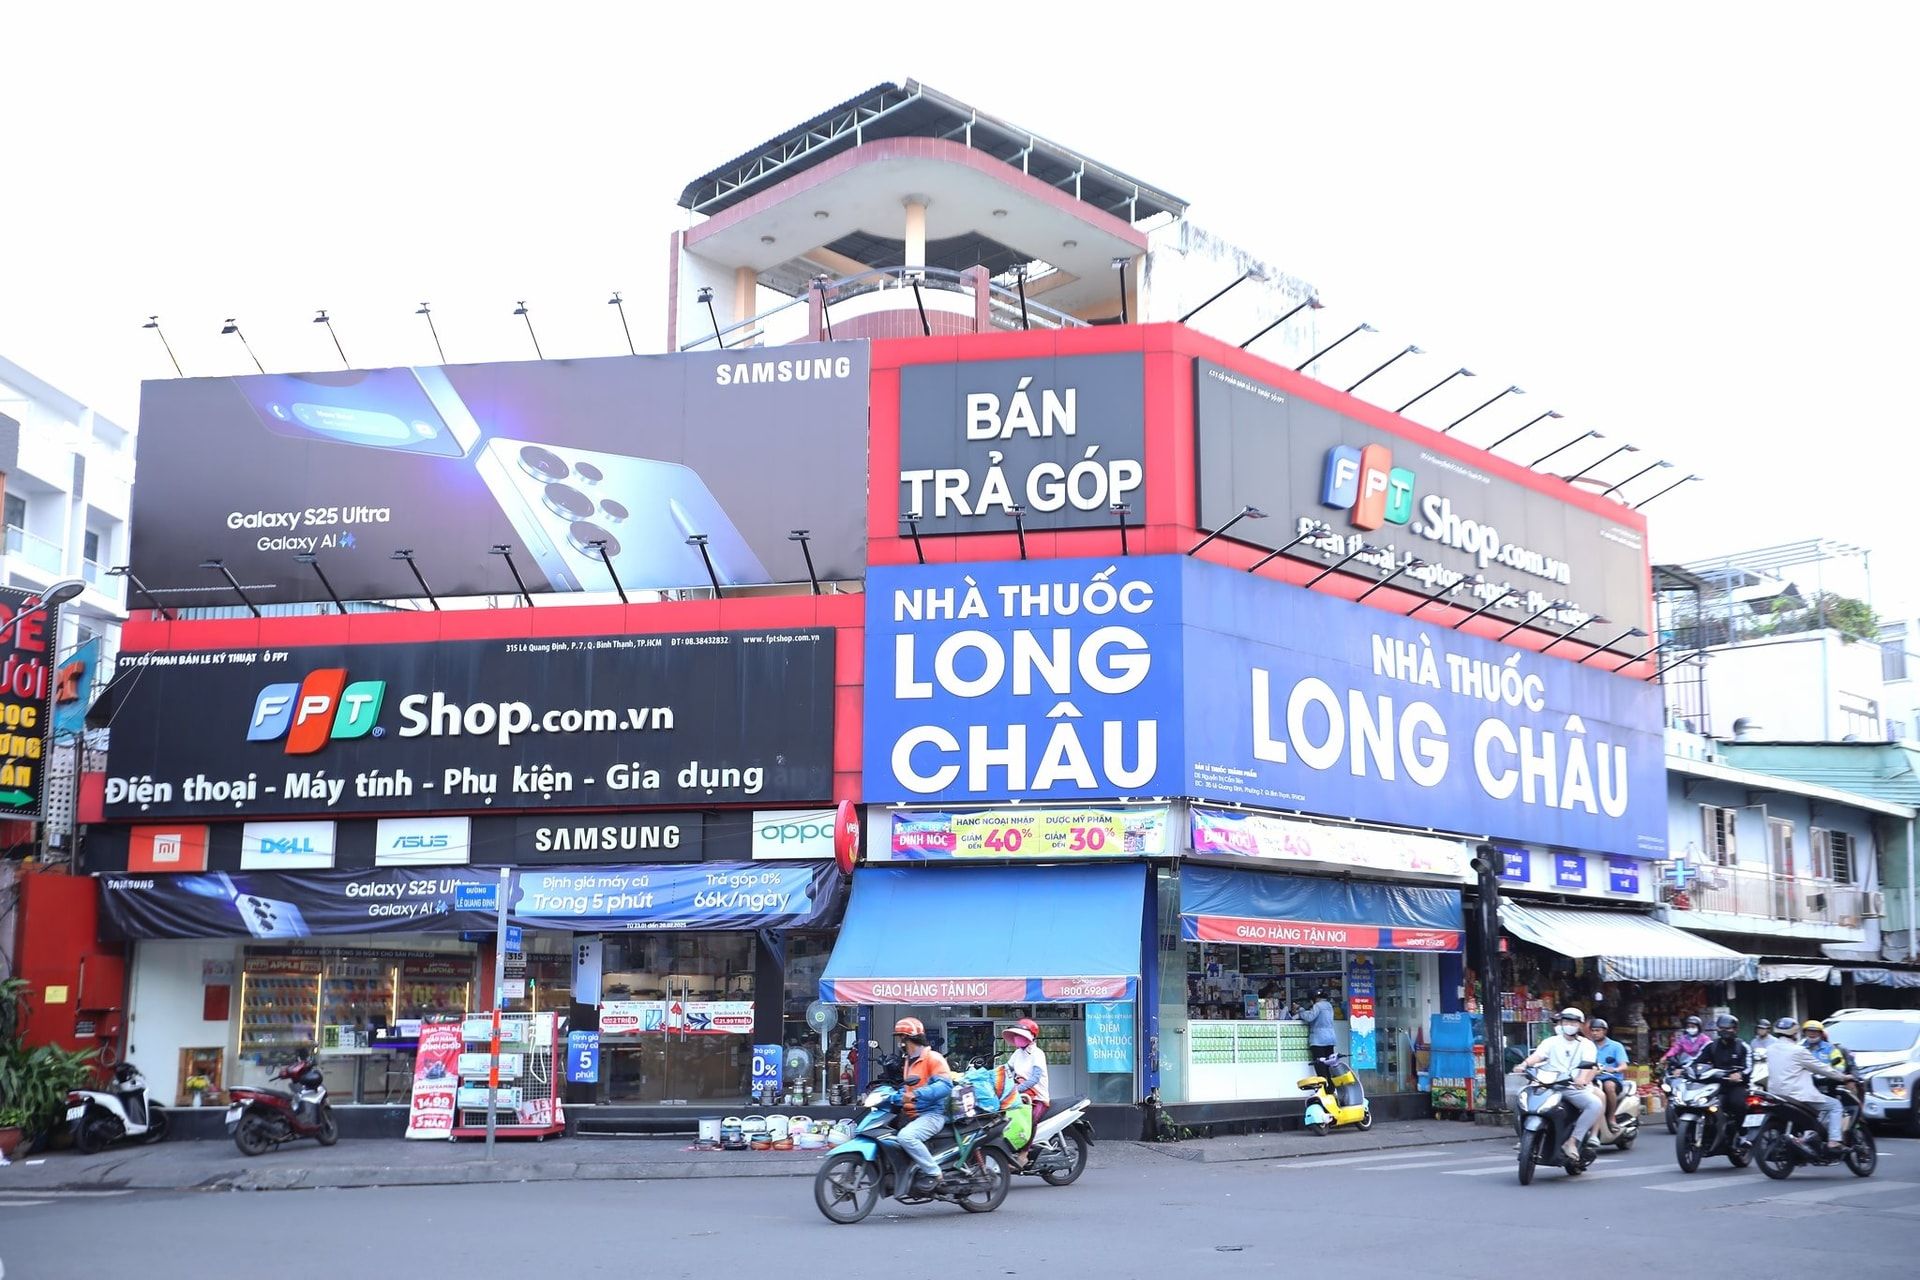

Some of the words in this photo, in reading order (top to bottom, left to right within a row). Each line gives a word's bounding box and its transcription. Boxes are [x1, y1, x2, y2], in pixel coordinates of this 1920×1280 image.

[716, 356, 851, 386] SAMSUNG
[966, 376, 1077, 441] BÁN
[900, 450, 1015, 519] TRẢ
[1025, 445, 1144, 514] GÓP
[226, 509, 301, 530] Galaxy
[304, 507, 338, 526] S25
[342, 505, 391, 525] Ultra
[257, 532, 318, 553] Galaxy
[321, 534, 337, 548] AI
[893, 575, 990, 622] NHÀ
[998, 565, 1154, 618] THUỐC
[506, 644, 518, 652] 315
[528, 643, 550, 653] Quang
[119, 656, 138, 667] CTY
[271, 652, 289, 662] FPT
[894, 625, 1152, 700] LONG
[1371, 631, 1441, 689] NHÀ
[1446, 651, 1545, 713] THUỐC
[400, 691, 674, 745] Shop.com.vn
[890, 701, 1158, 795] CHÂU
[1251, 667, 1450, 788] LONG
[1473, 714, 1628, 819] CHÂU
[105, 775, 172, 811] Điện
[183, 772, 257, 808] thoại
[284, 772, 345, 806] Máy
[355, 769, 413, 797] tính
[444, 767, 497, 805] Phụ
[513, 764, 573, 800] kiện
[606, 763, 660, 791] Gia
[677, 760, 764, 795] dụng
[392, 835, 449, 849] ASUS
[534, 825, 680, 852] SAMSUNG
[761, 824, 835, 844] oppo
[259, 837, 314, 854] DELL
[107, 879, 155, 890] SAMSUNG
[345, 881, 407, 900] Galaxy
[408, 879, 436, 895] S25
[466, 886, 487, 895] ĐƯỜNG
[542, 876, 572, 891] Định
[574, 875, 596, 891] giá
[598, 874, 629, 891] máy
[632, 874, 650, 887] cũ
[706, 873, 728, 886] Trả
[730, 872, 758, 889] góp
[761, 873, 781, 885] 0%
[368, 903, 418, 919] Galaxy
[420, 901, 433, 915] AI
[456, 898, 464, 908] LÊ
[463, 898, 482, 908] QUANG
[533, 892, 588, 915] Trong
[592, 893, 605, 909] 5
[607, 890, 654, 914] phút
[694, 889, 792, 913] 66k/ngày
[1236, 925, 1267, 939] GIAO
[1268, 924, 1300, 940] HÀNG
[1303, 927, 1326, 945] TẬN
[1327, 929, 1347, 944] NƠI
[270, 961, 300, 970] APPLE
[872, 982, 904, 997] GIAO
[905, 980, 939, 997] HÀNG
[940, 980, 966, 999] TẬN
[968, 980, 989, 997] NƠI
[1060, 986, 1082, 996] 1800
[572, 1034, 587, 1042] Định
[580, 1051, 592, 1069] 5
[752, 1056, 777, 1076] 0%
[575, 1071, 594, 1081] phút
